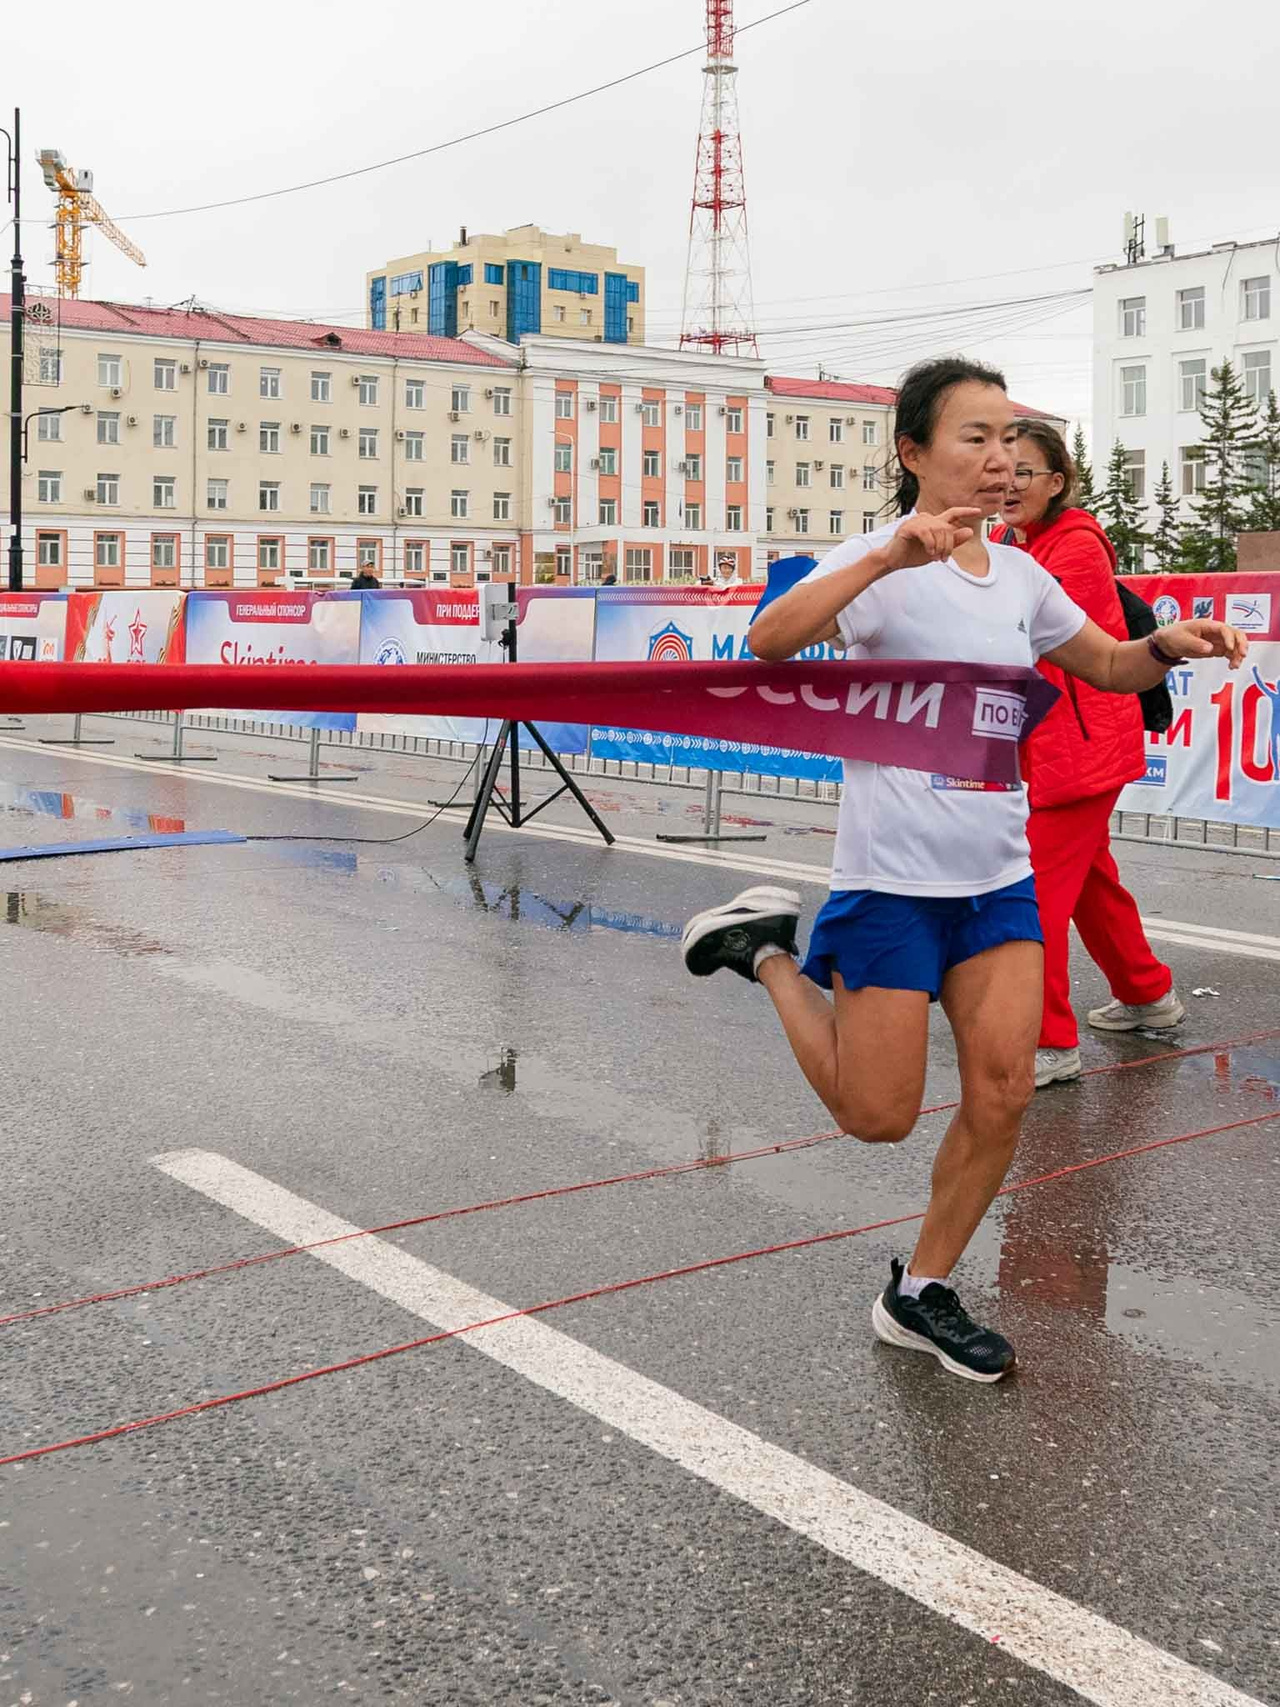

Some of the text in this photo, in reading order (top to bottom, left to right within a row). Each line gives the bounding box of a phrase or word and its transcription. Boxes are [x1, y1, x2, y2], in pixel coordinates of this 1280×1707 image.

[236, 602, 306, 616] ГЕНЕРАЛЬНЫЙ СПОНСОР
[436, 605, 451, 618] ПРИ
